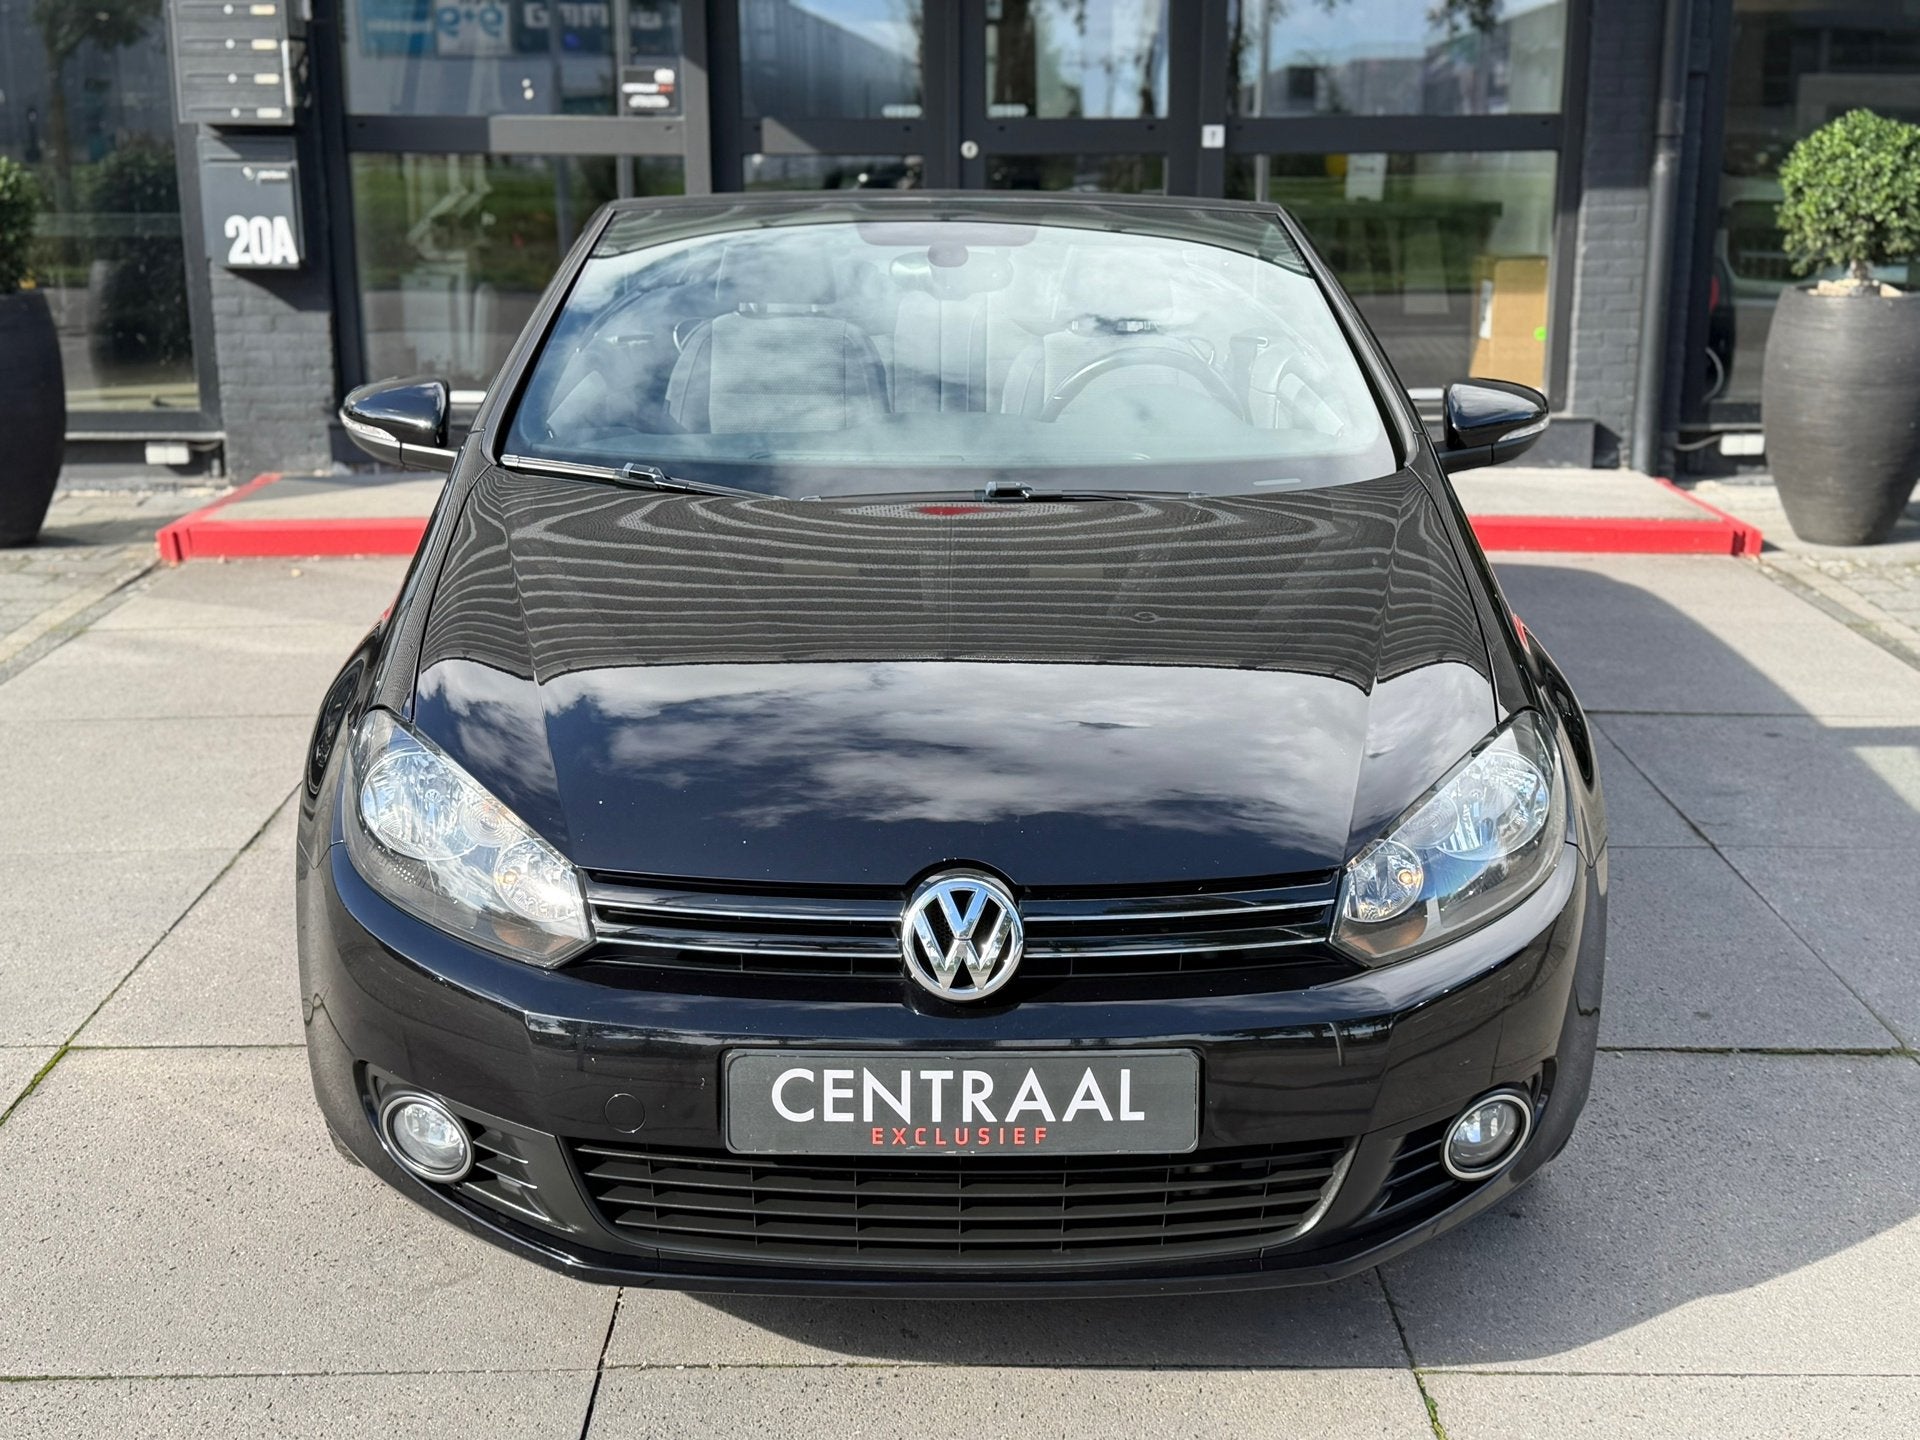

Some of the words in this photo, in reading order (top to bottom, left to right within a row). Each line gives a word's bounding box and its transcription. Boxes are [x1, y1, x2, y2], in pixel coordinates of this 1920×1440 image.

[224, 214, 299, 264] 20A
[907, 881, 1017, 995] VW
[771, 1067, 1145, 1124] CENTRAAL
[871, 1127, 1049, 1145] EXCLUSIEF
